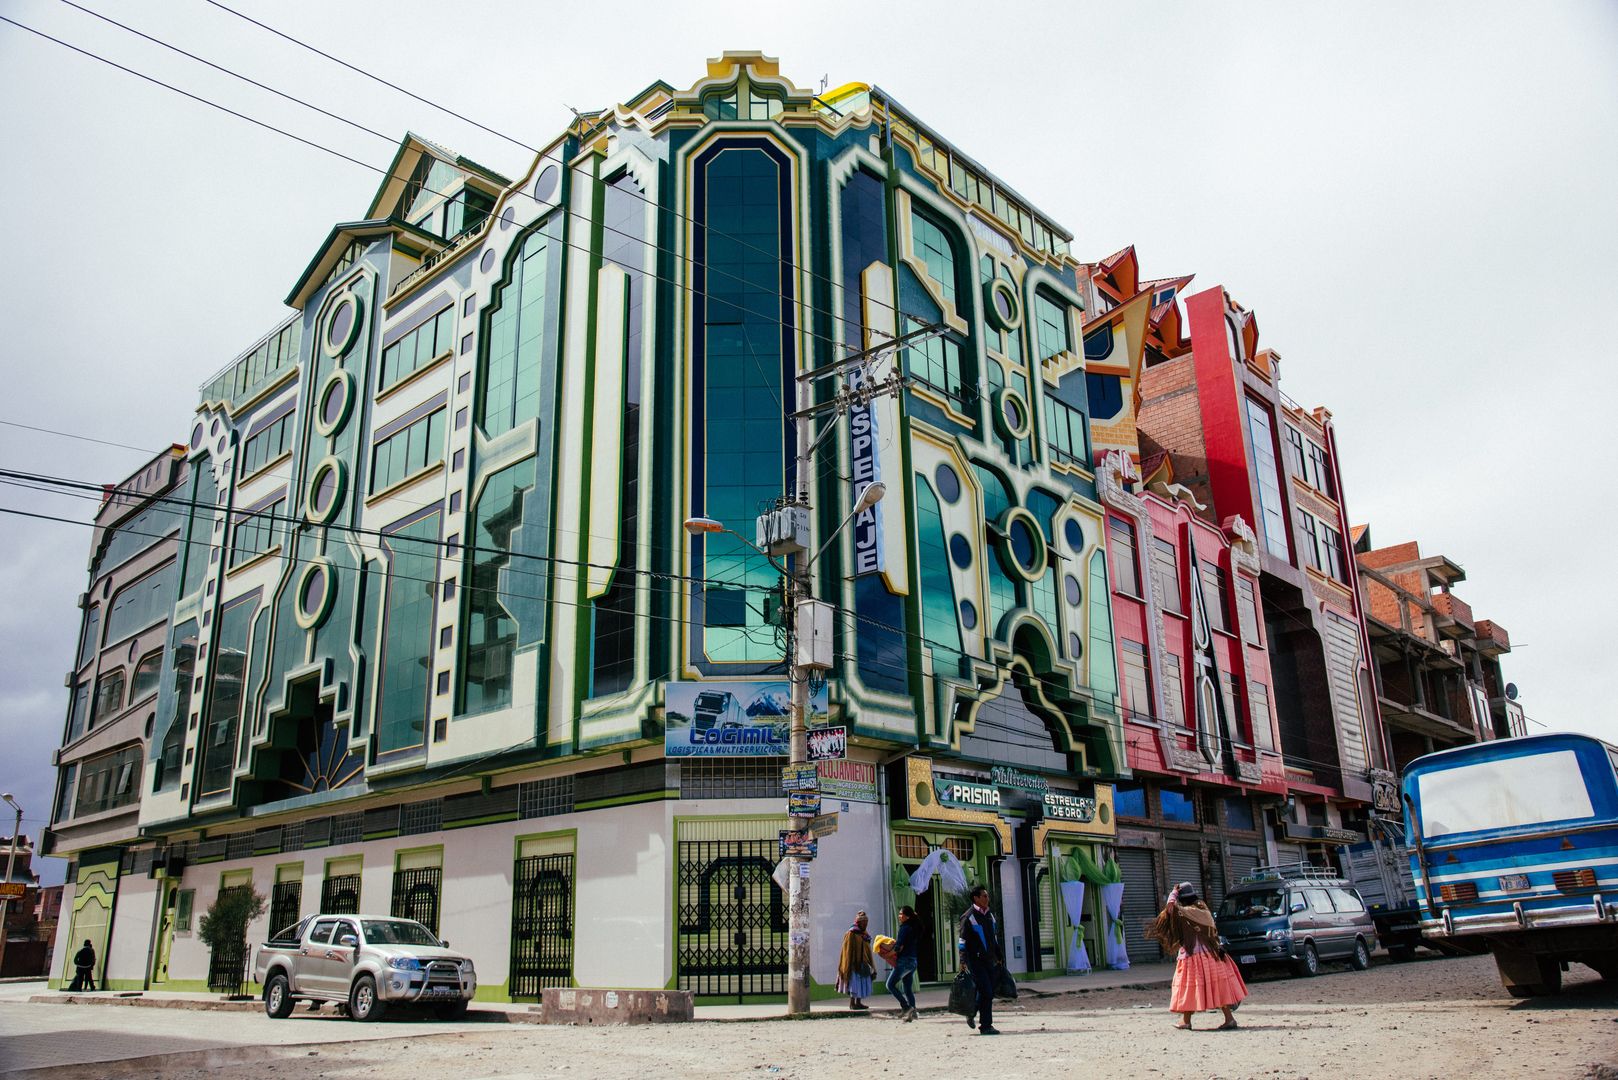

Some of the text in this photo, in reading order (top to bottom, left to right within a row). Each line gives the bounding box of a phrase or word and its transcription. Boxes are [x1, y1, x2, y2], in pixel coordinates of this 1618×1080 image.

[817, 760, 875, 784] ALOJAMIENTO
[953, 785, 1001, 806] PRISMA
[1044, 794, 1086, 808] ESTRELLA
[1052, 806, 1082, 818] DE ORO
